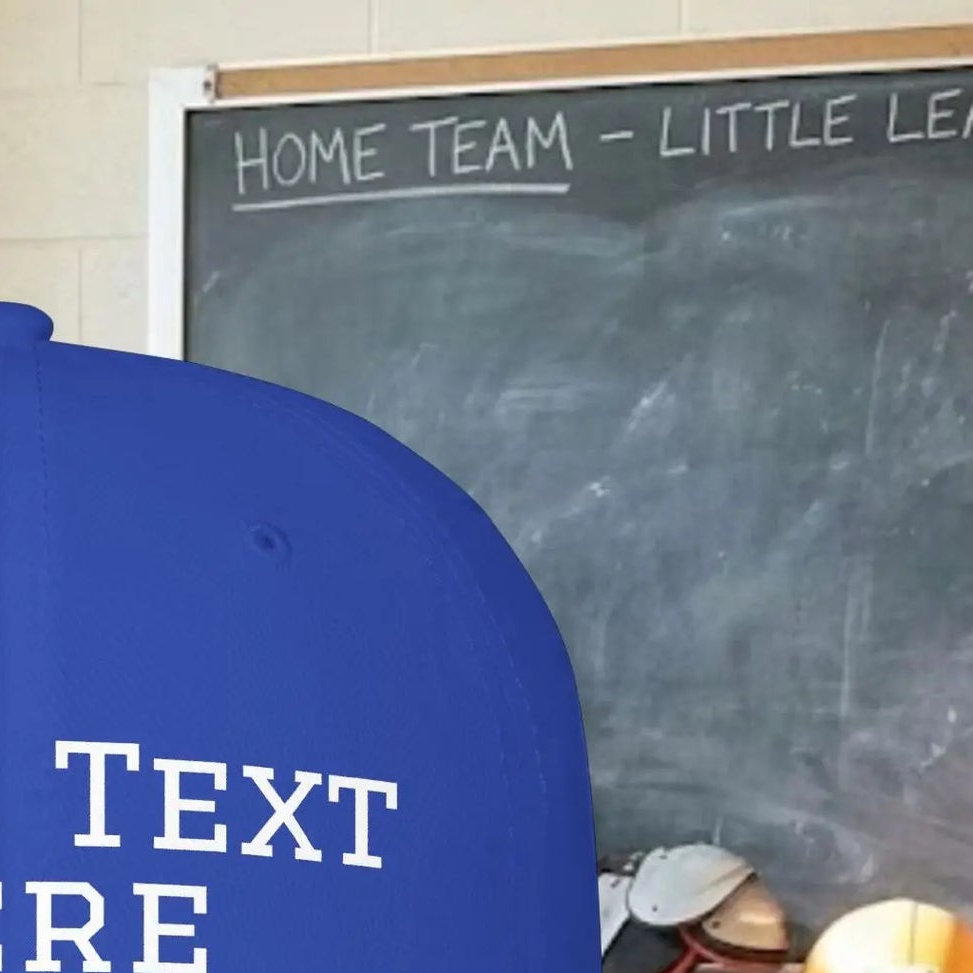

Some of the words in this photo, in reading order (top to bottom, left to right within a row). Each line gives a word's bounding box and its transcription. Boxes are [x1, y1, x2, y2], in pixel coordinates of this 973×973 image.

[234, 123, 386, 195] HOME
[409, 111, 573, 177] TEAM
[659, 94, 858, 157] LITTLE
[56, 741, 397, 868] TEXT
